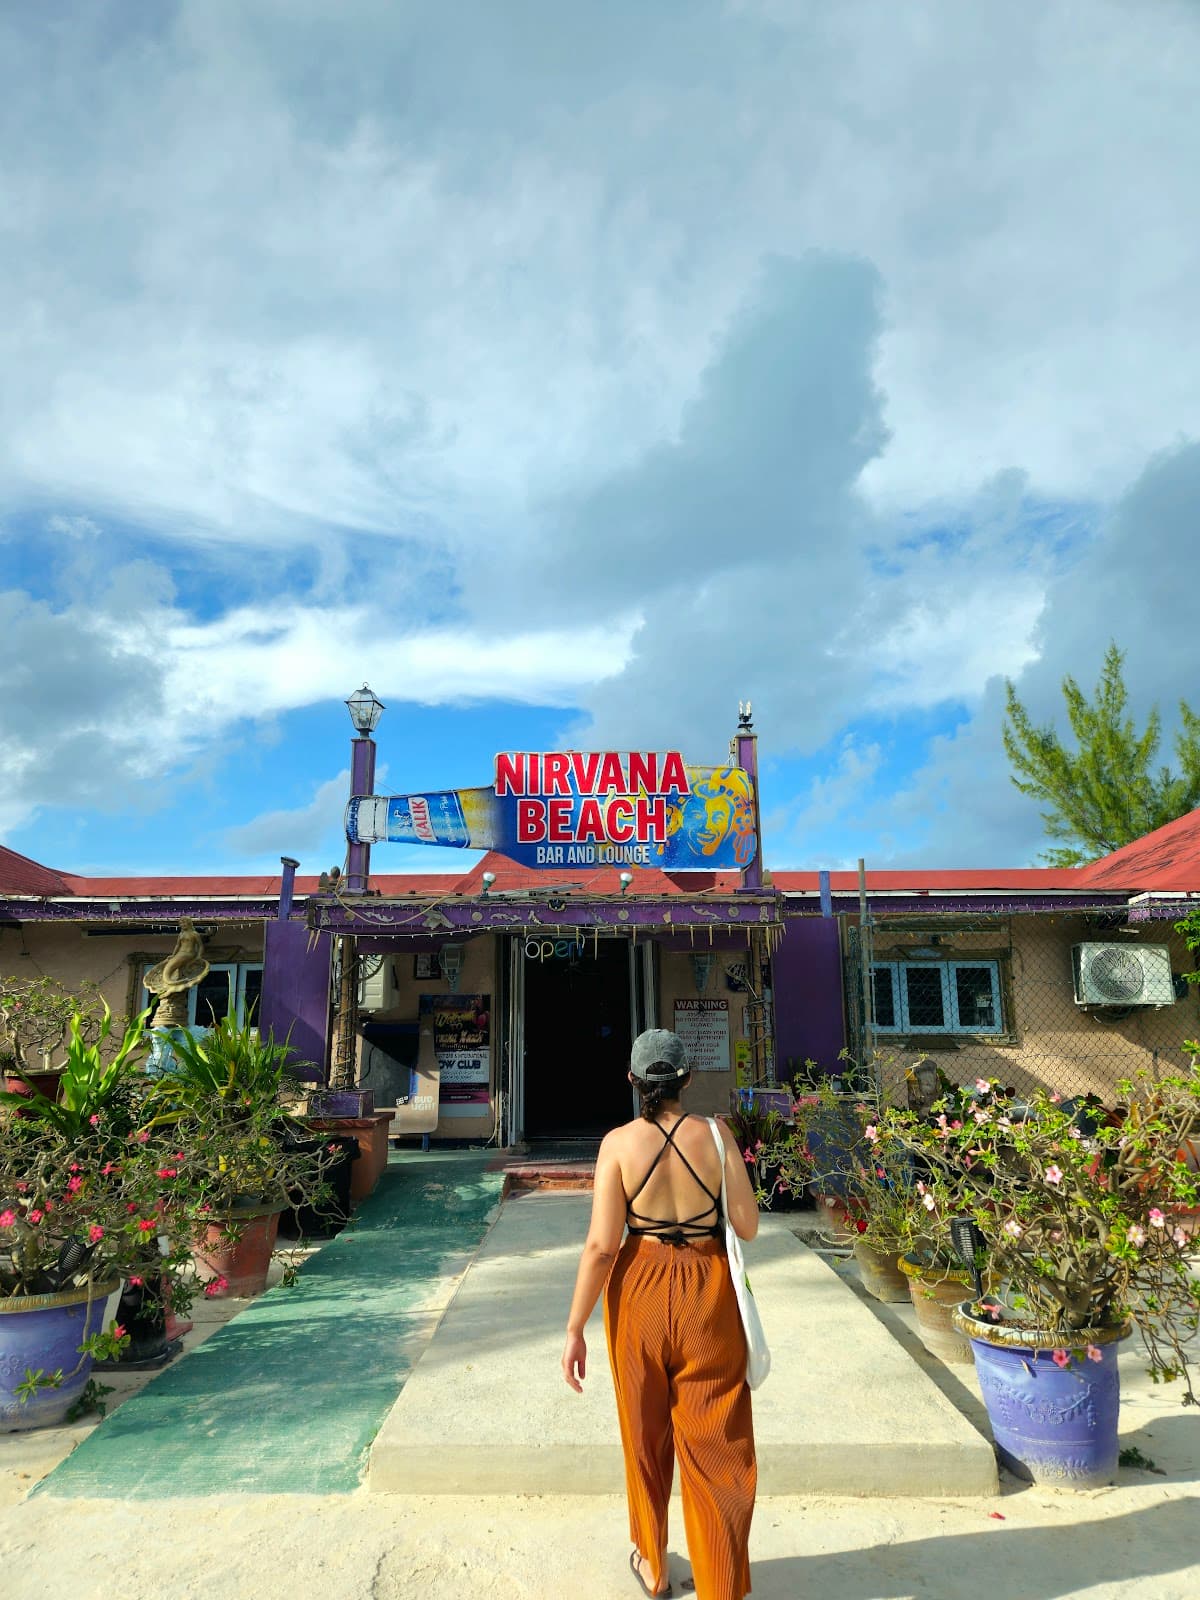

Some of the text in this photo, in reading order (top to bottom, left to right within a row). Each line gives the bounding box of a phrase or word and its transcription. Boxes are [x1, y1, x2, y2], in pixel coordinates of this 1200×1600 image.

[495, 751, 690, 796] NIRVANA
[412, 800, 432, 838] KALIK
[517, 797, 667, 844] BEACH
[536, 845, 650, 864] BAR AND LOUNGE
[525, 940, 584, 964] open
[676, 1000, 728, 1010] WARNING
[457, 1060, 481, 1069] CLUB
